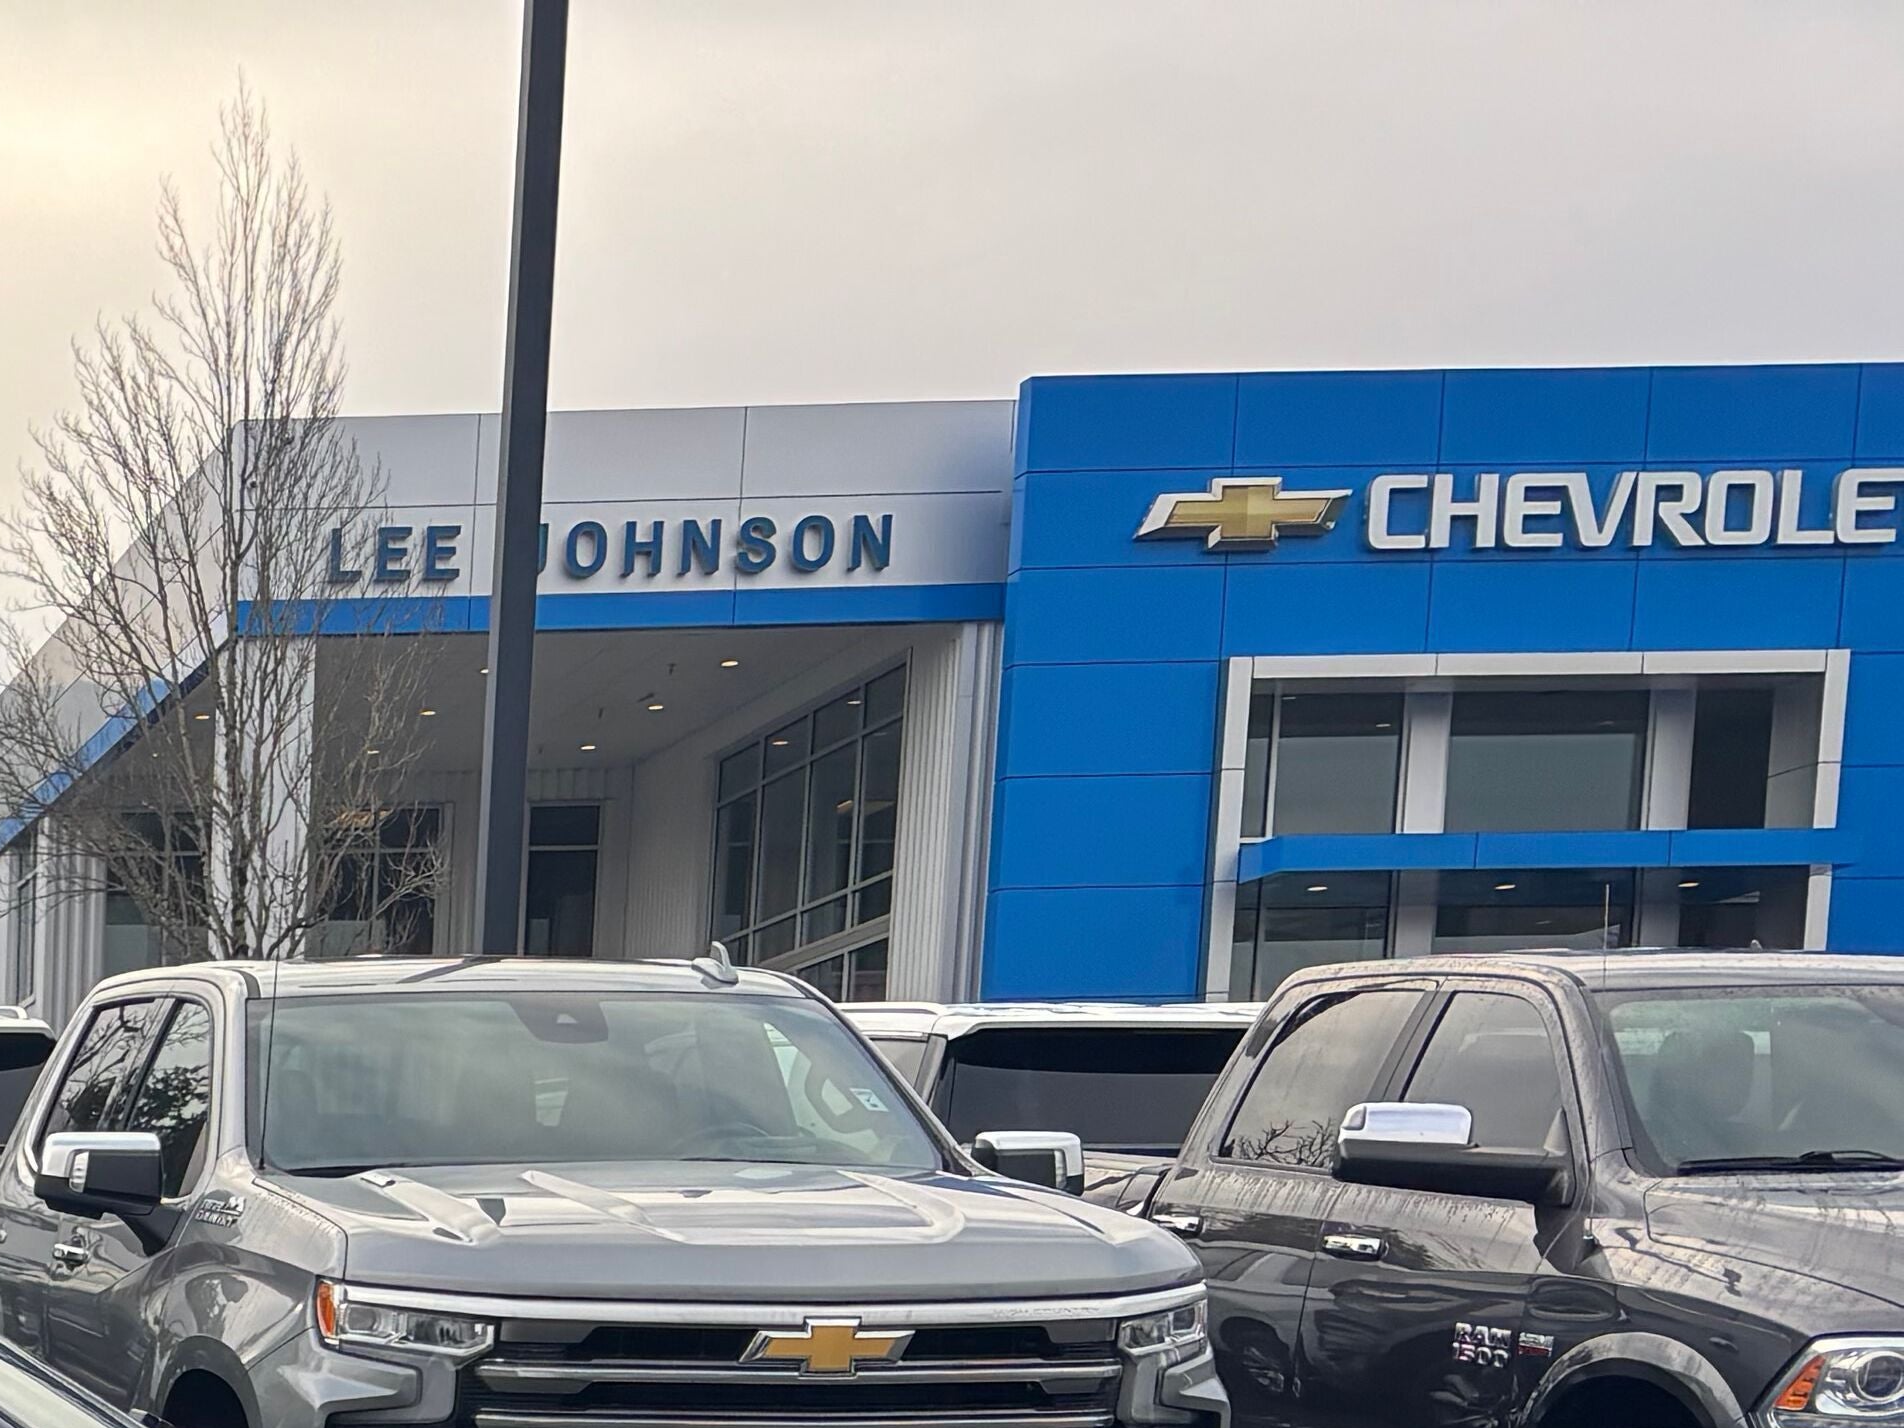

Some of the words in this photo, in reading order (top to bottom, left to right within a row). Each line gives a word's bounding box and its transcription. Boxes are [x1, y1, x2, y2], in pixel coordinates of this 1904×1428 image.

[1368, 468, 1904, 549] CHEVROLE
[329, 525, 462, 582] LEE
[1452, 1342, 1509, 1369] 1500
[1454, 1322, 1512, 1348] RAM
